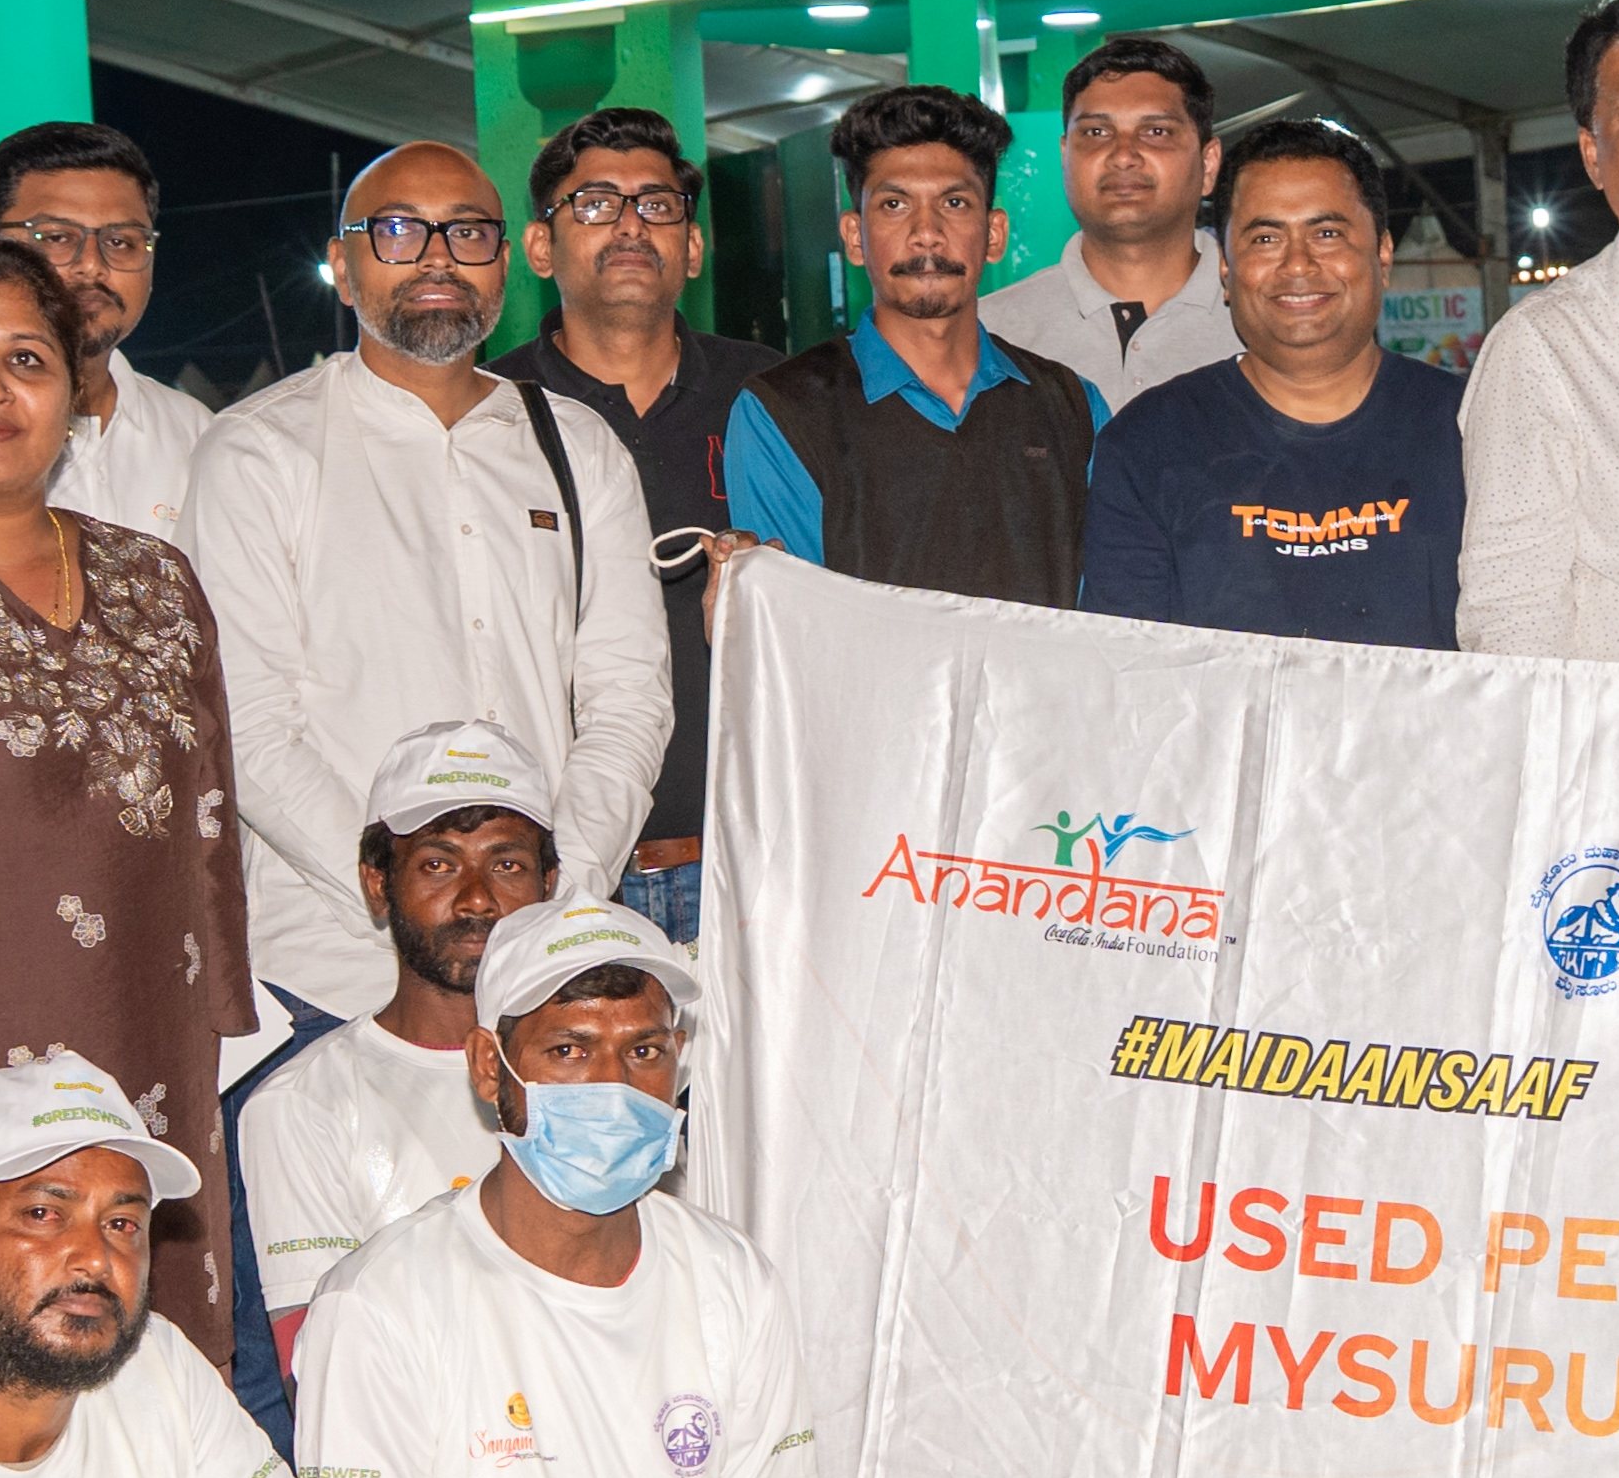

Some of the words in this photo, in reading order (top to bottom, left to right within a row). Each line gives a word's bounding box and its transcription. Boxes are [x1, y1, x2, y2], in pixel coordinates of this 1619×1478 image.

[1231, 498, 1410, 544] TOMMY
[1275, 538, 1369, 557] JEANS
[861, 832, 1225, 942] Anandana
[1091, 931, 1125, 952] India
[1126, 936, 1219, 963] Foundation
[1111, 1015, 1599, 1121] #MAIDAANSAAF
[1149, 1176, 1444, 1286] USED
